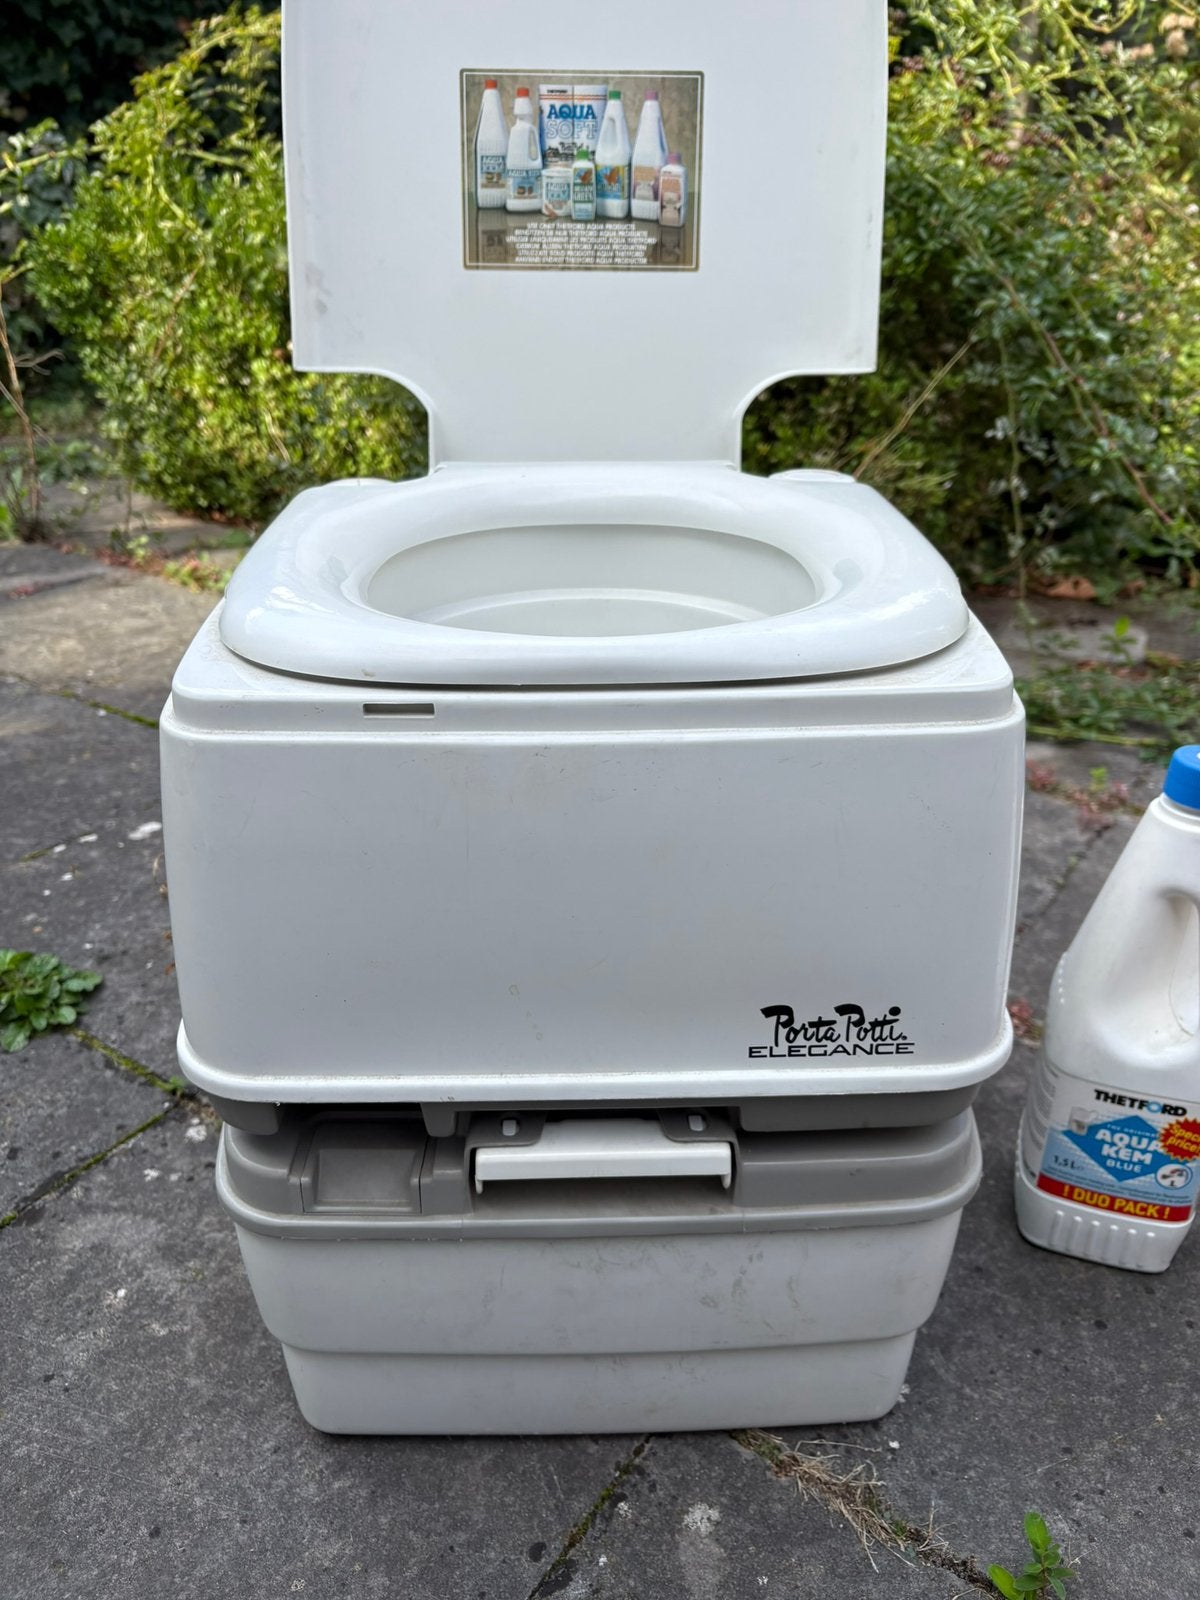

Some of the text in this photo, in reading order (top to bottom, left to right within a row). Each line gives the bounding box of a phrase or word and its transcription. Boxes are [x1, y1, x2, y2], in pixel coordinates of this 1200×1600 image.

[547, 103, 597, 120] AQUA
[546, 120, 597, 140] SOFT
[760, 1004, 841, 1047] Porta
[748, 1042, 915, 1058] ELEGANCE
[1094, 1088, 1188, 1117] THETFORD
[1095, 1128, 1164, 1154] AQUA
[1101, 1143, 1153, 1166] KEM
[1106, 1159, 1143, 1174] BLUE
[1073, 1186, 1111, 1209] DUO
[1114, 1197, 1158, 1219] PACK
